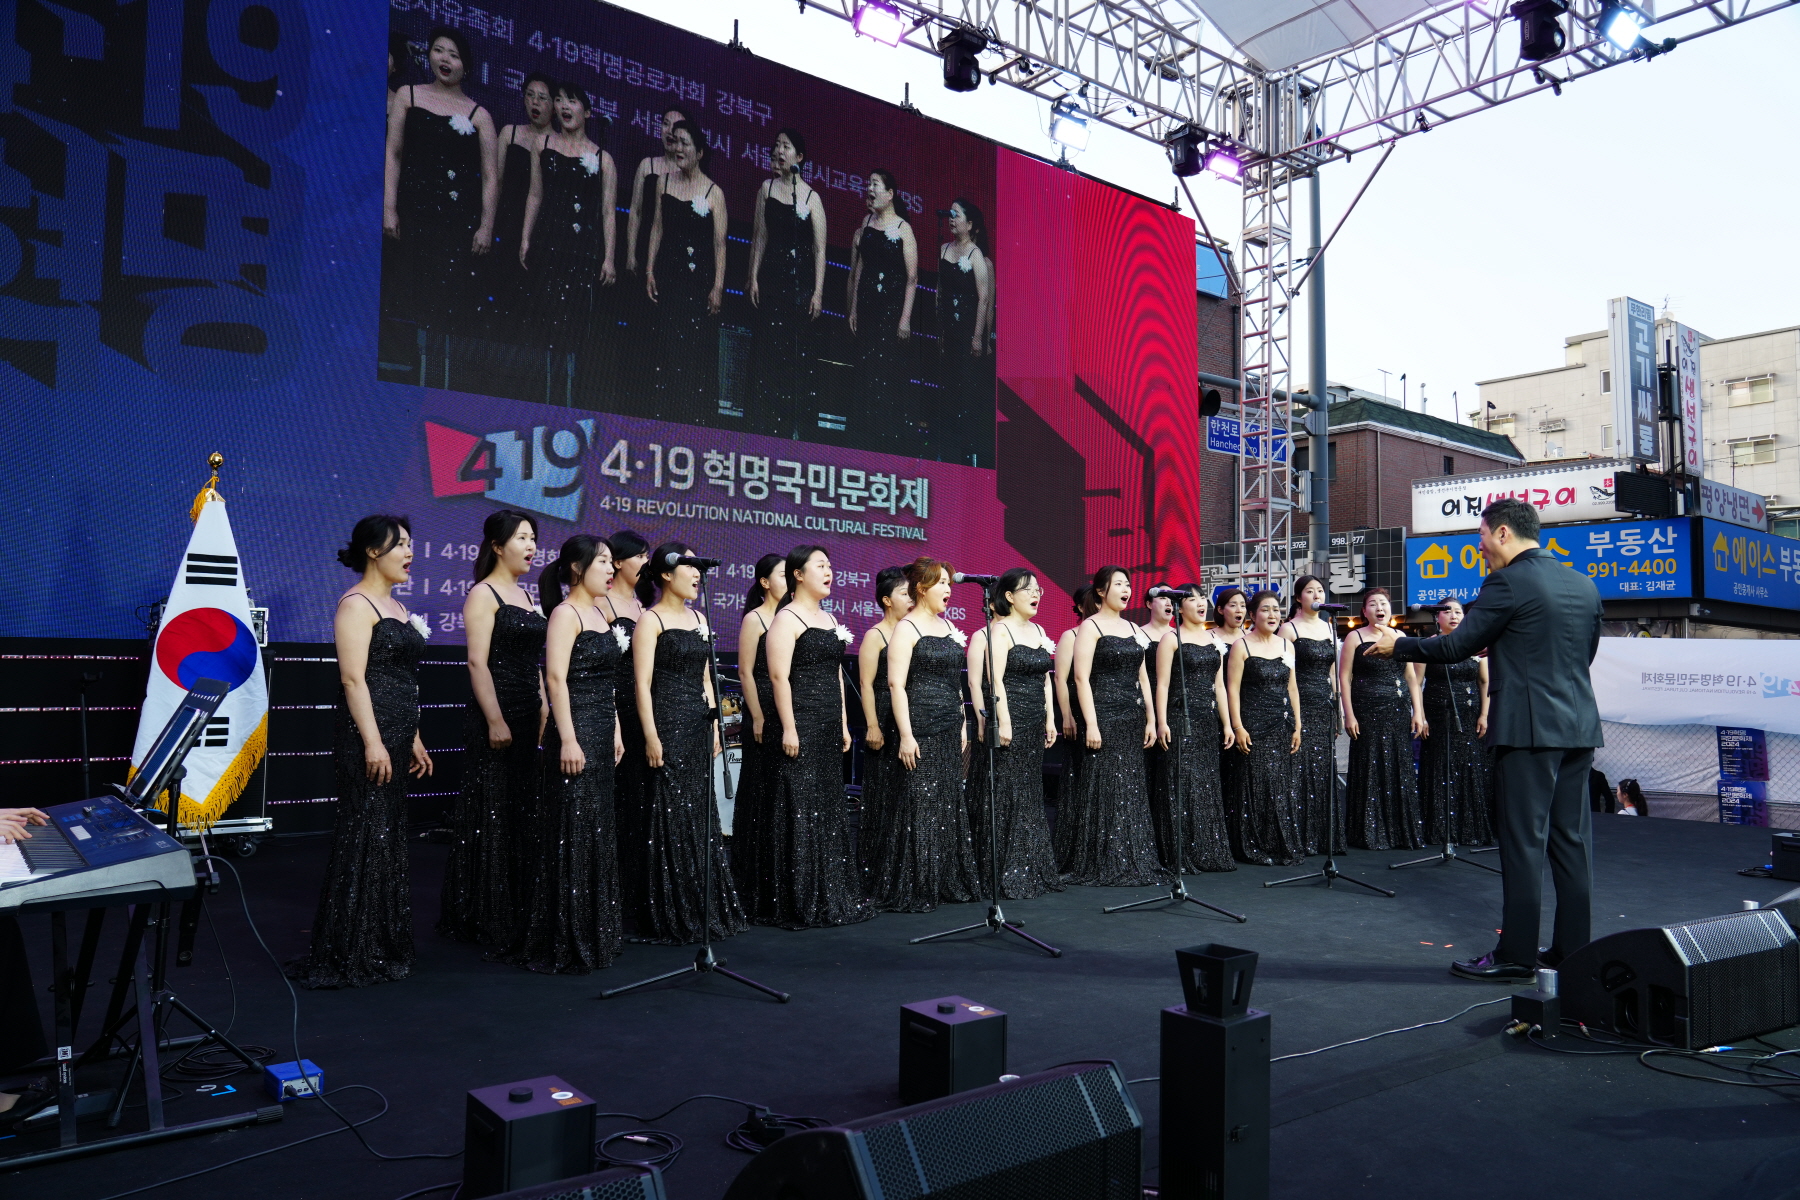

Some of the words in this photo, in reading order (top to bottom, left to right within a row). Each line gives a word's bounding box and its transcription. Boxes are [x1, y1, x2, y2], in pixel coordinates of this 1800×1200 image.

[716, 89, 773, 126] 강북구
[1210, 419, 1240, 437] 한천로
[1700, 484, 1750, 523] 평양냉면
[636, 498, 729, 522] REVOLUTION
[732, 508, 802, 529] NATIONAL
[805, 516, 870, 535] CULTURAL
[872, 524, 928, 541] FESTIVAL
[1586, 526, 1678, 558] 부동산
[1732, 536, 1777, 579] 에이스
[1586, 558, 1677, 578] 991-4400
[835, 571, 870, 588] 강북구
[1619, 582, 1643, 593] 대표:
[1645, 580, 1676, 591] 김재균
[1417, 588, 1468, 601] 공인중개사
[944, 606, 967, 621] KBS
